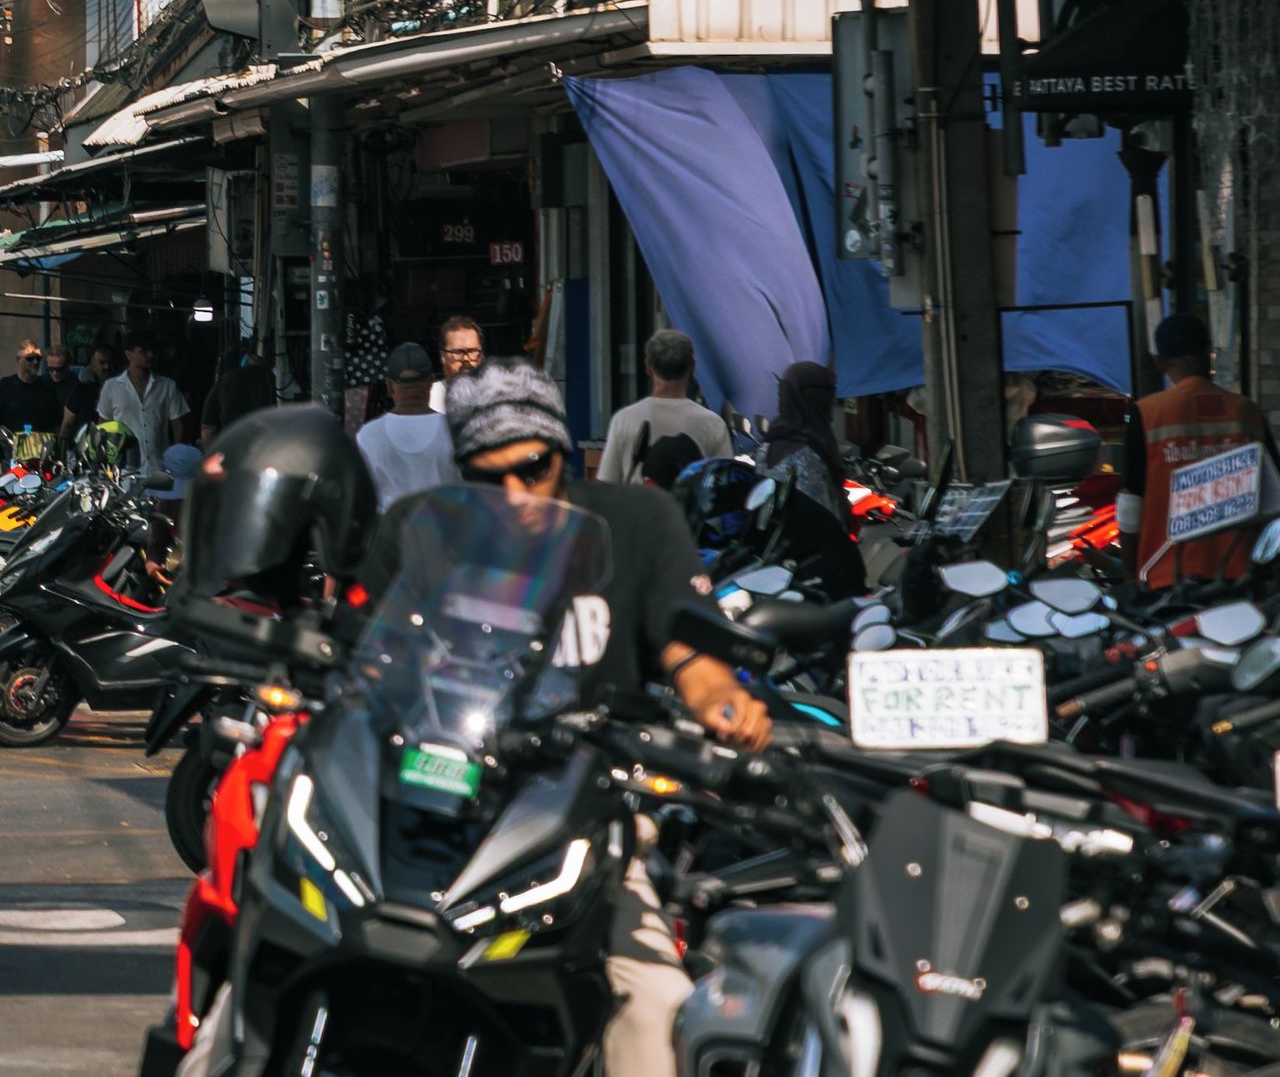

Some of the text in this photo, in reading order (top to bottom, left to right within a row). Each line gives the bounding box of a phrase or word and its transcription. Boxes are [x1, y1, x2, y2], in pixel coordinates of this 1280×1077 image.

[1091, 76, 1138, 92] BEST
[443, 225, 474, 242] 299
[494, 243, 522, 263] 150
[862, 685, 1032, 713] FOR RENT
